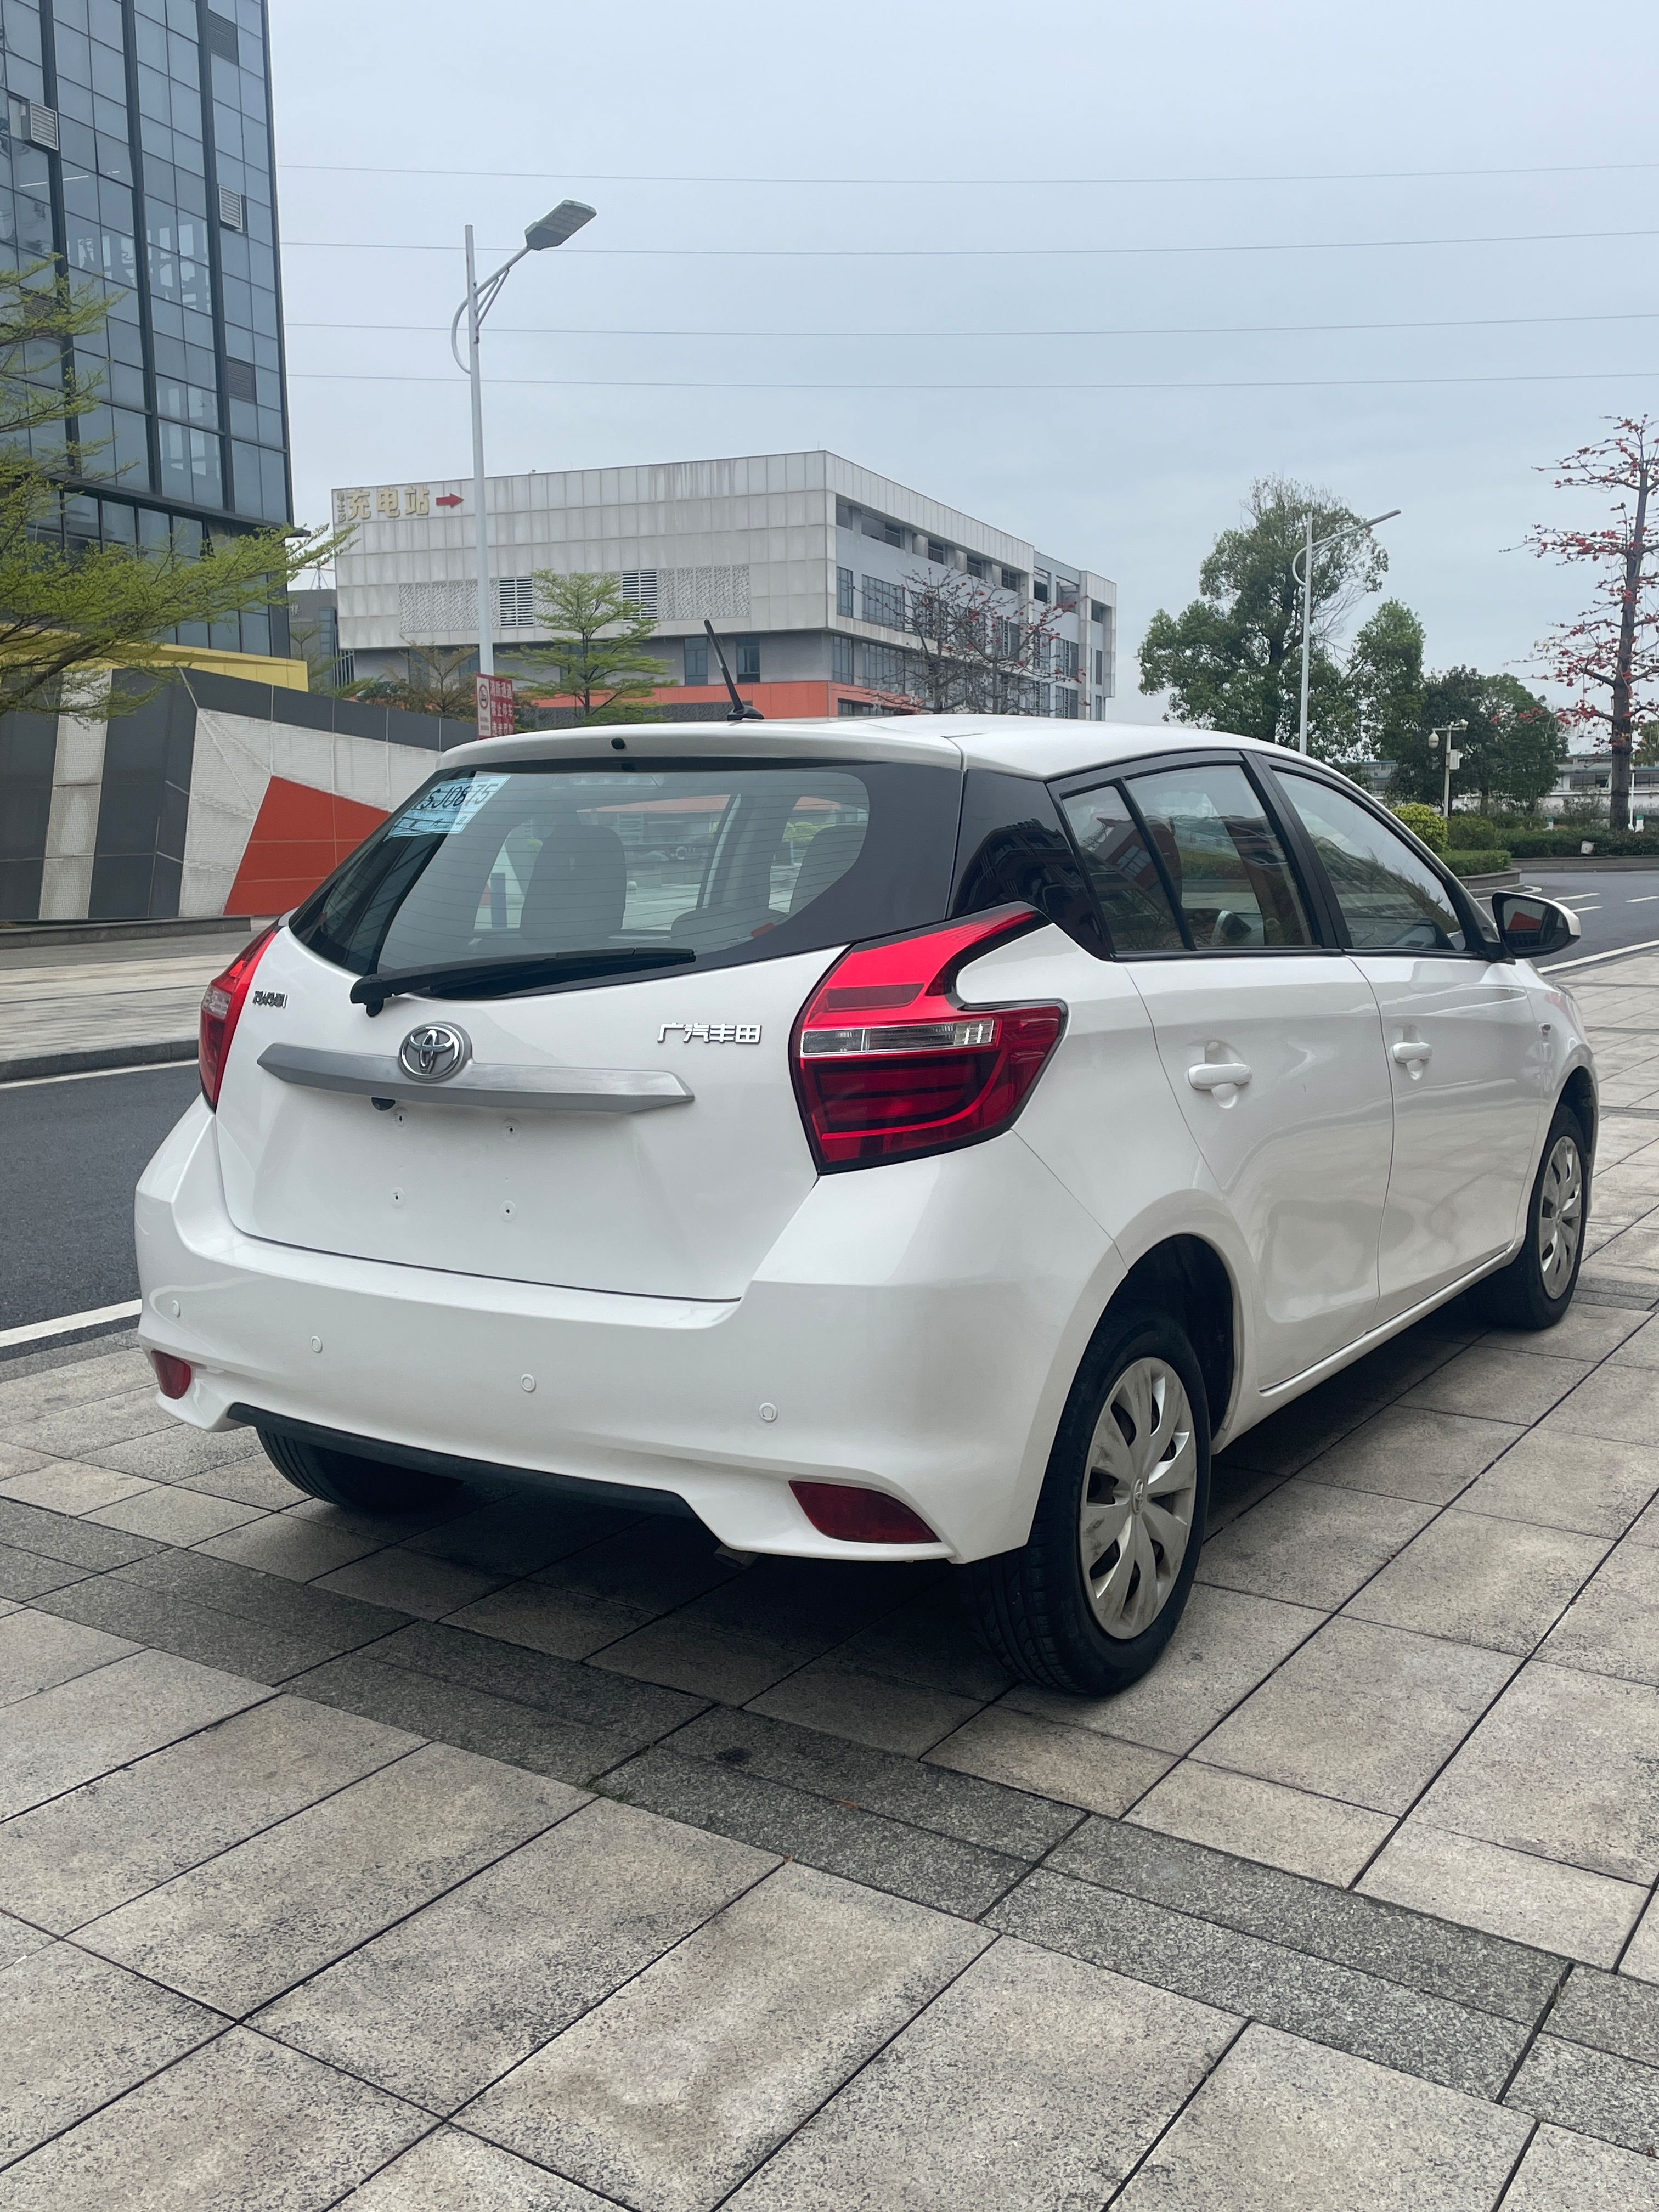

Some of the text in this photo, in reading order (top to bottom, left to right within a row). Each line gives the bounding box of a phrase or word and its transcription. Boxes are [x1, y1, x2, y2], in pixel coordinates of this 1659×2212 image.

[346, 485, 430, 520] 充电站
[490, 680, 512, 699] 消防通道
[490, 701, 514, 720] 禁止停车
[657, 1022, 762, 1045] 广汽丰田
